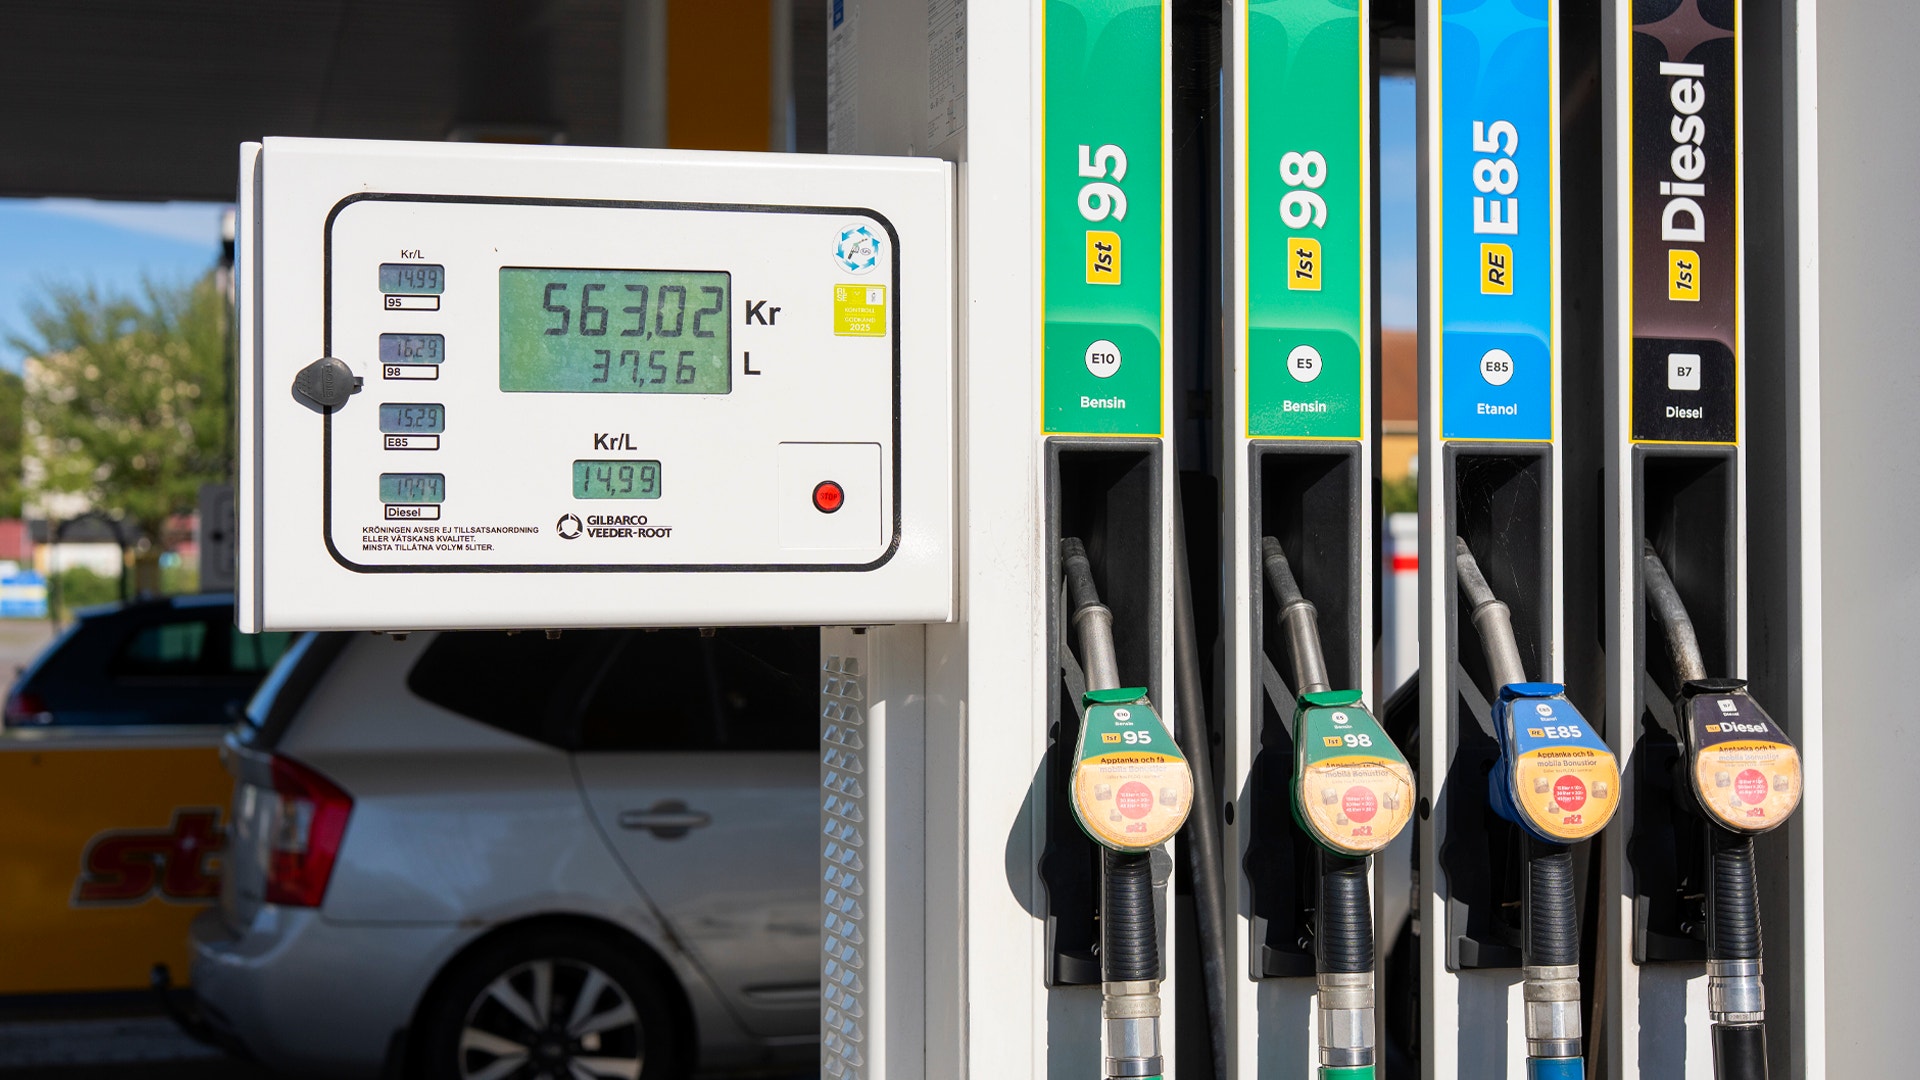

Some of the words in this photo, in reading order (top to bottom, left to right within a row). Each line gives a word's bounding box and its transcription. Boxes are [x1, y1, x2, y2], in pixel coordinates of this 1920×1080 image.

[1660, 61, 1706, 242] Diesel
[1077, 144, 1128, 223] 95
[1472, 120, 1519, 235] E85
[1279, 150, 1328, 230] 98
[401, 249, 425, 259] Kr/L
[1094, 241, 1112, 273] 1st
[1296, 248, 1313, 280] 1st
[1488, 251, 1505, 286] RE
[1675, 261, 1693, 290] 1st
[387, 298, 402, 307] 95
[543, 283, 724, 341] 563,02
[745, 299, 781, 326] Kr
[849, 323, 871, 332] 2025
[1091, 353, 1115, 365] E10
[1296, 358, 1313, 369] E5
[386, 367, 401, 377] 98
[591, 350, 697, 388] 37,56
[743, 351, 762, 376] L
[1485, 361, 1509, 373] E85
[1677, 366, 1692, 378] B7
[1080, 396, 1126, 409] Bensin
[1283, 400, 1327, 413] Bensin
[1476, 403, 1518, 416] Etanol
[1666, 406, 1703, 419] Diesel
[387, 438, 408, 447] E85
[594, 433, 638, 451] Kr/L
[583, 465, 656, 496] 14,99
[820, 492, 838, 501] STOP
[388, 508, 421, 517] Diesel
[587, 515, 648, 526] GILBARCO
[587, 527, 673, 539] VEEDER-ROOT
[362, 543, 393, 551] MINSTA
[435, 543, 463, 551] VOLYM
[1544, 725, 1582, 739] E85
[1719, 721, 1769, 733] Diesel
[1122, 731, 1152, 744] 95
[1343, 733, 1373, 748] 98
[1100, 757, 1139, 765] Apptanka
[70, 806, 232, 908] st
